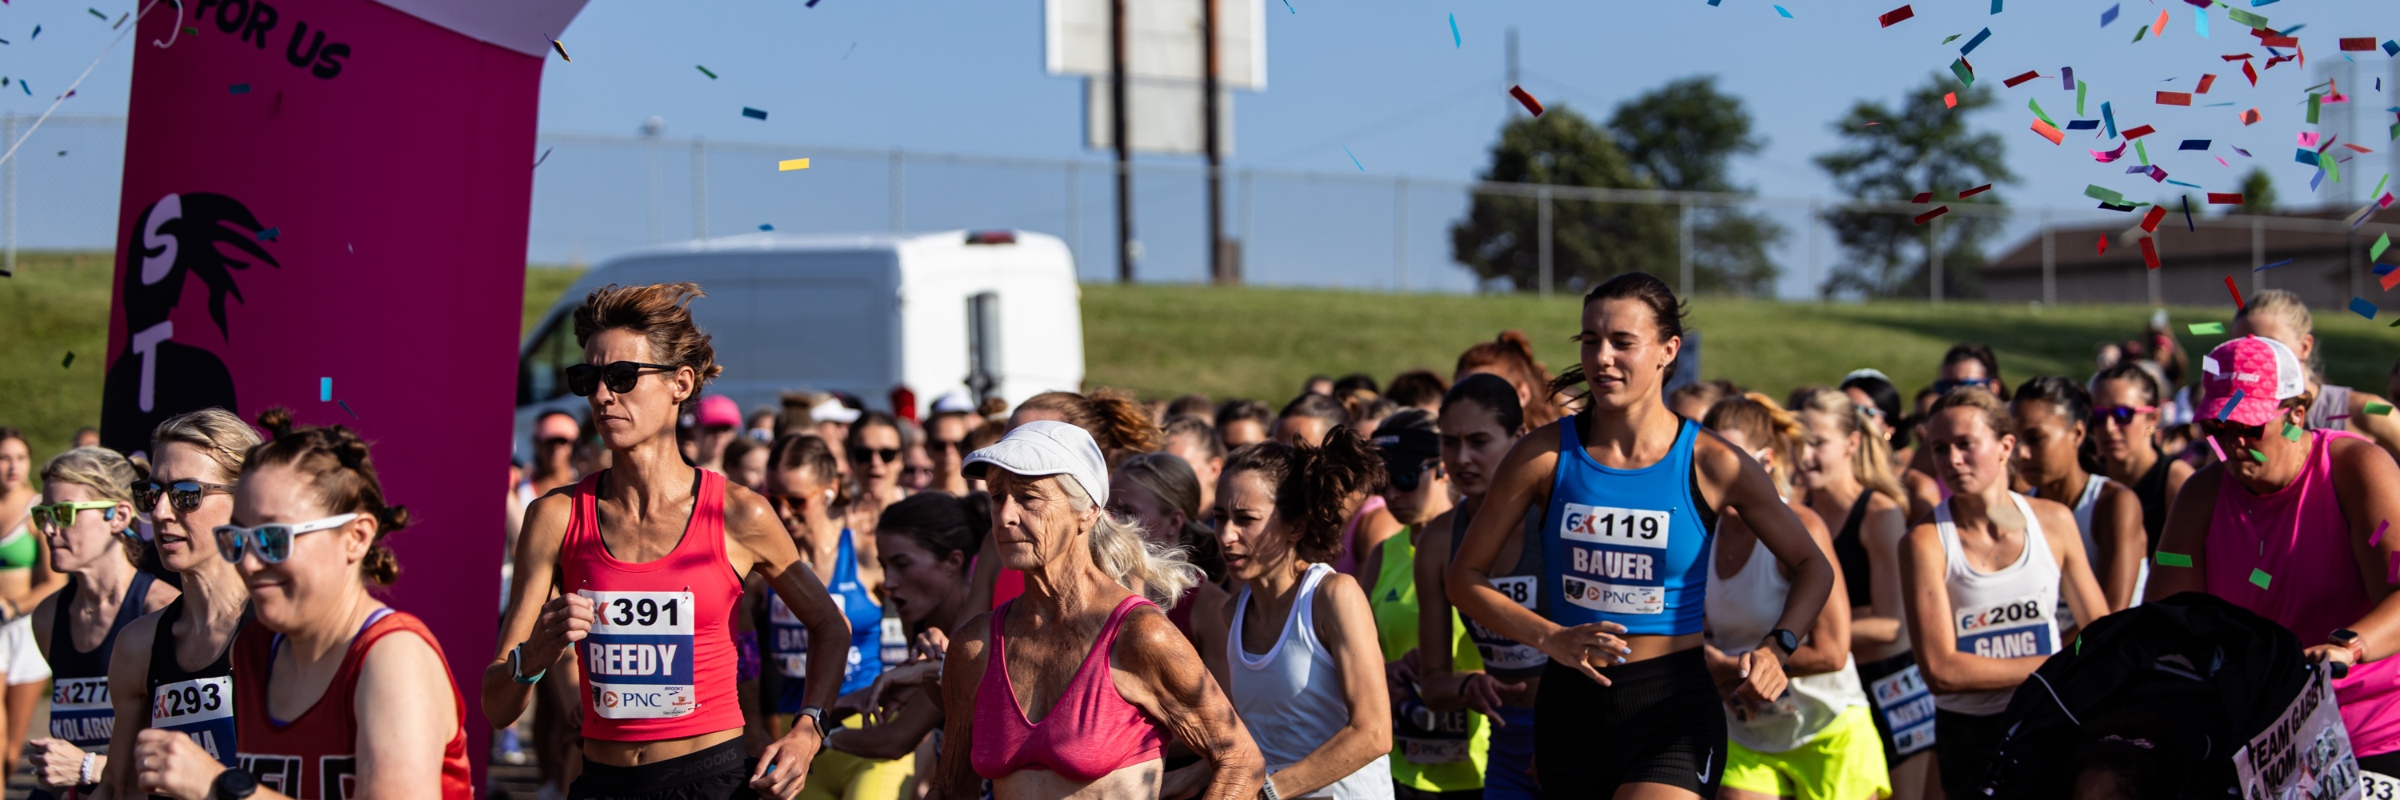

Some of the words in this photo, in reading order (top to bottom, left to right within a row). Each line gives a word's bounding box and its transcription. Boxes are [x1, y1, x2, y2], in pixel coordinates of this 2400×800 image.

[286, 20, 351, 80] US
[1600, 513, 1658, 540] 119
[1572, 547, 1654, 581] BAUER
[1602, 590, 1636, 605] PNC
[612, 598, 678, 626] 391
[1990, 600, 2040, 625] 208
[1974, 630, 2037, 659] GANG
[589, 642, 678, 676] REEDY
[72, 681, 108, 704] 277
[167, 683, 222, 717] 293
[621, 692, 662, 707] PNC
[2247, 718, 2290, 775] TEAM
[2291, 669, 2326, 735] GABBY
[684, 747, 738, 775] BROOKS
[2262, 742, 2297, 798] MOM
